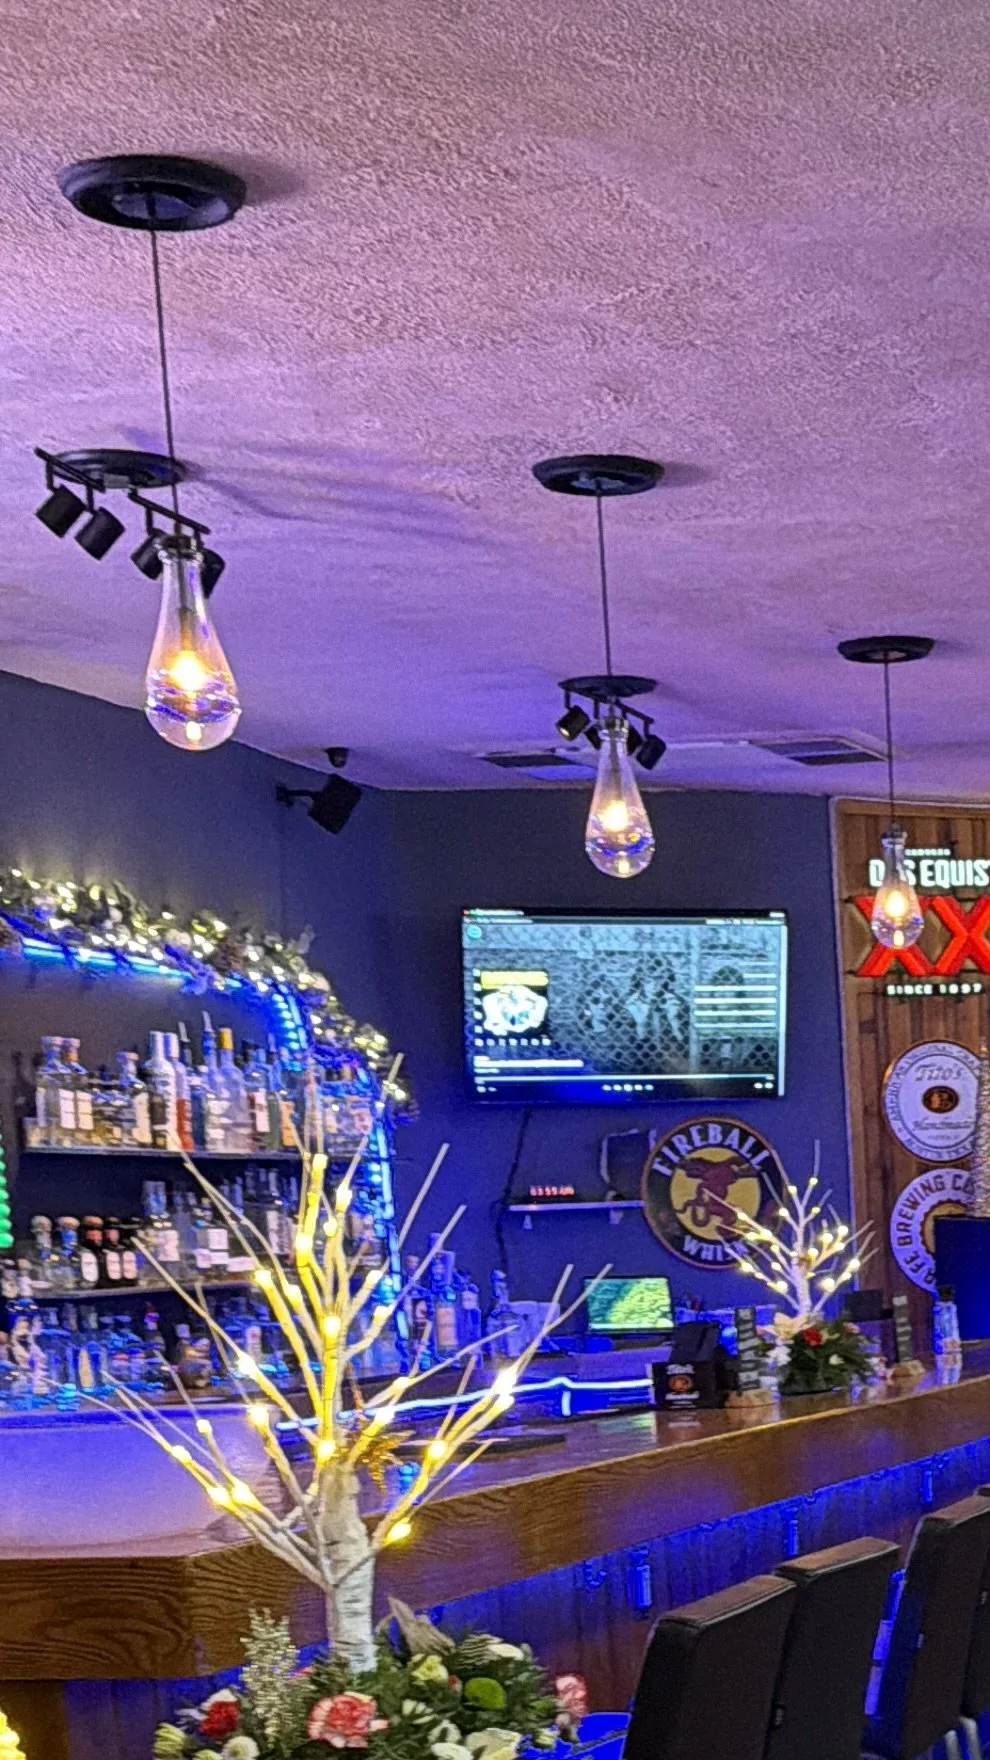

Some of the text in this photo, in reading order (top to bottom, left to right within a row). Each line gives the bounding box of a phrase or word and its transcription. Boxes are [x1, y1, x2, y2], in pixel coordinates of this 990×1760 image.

[869, 859, 917, 887] DS
[652, 1123, 770, 1176] FIREBALL
[896, 1174, 945, 1247] BREWING
